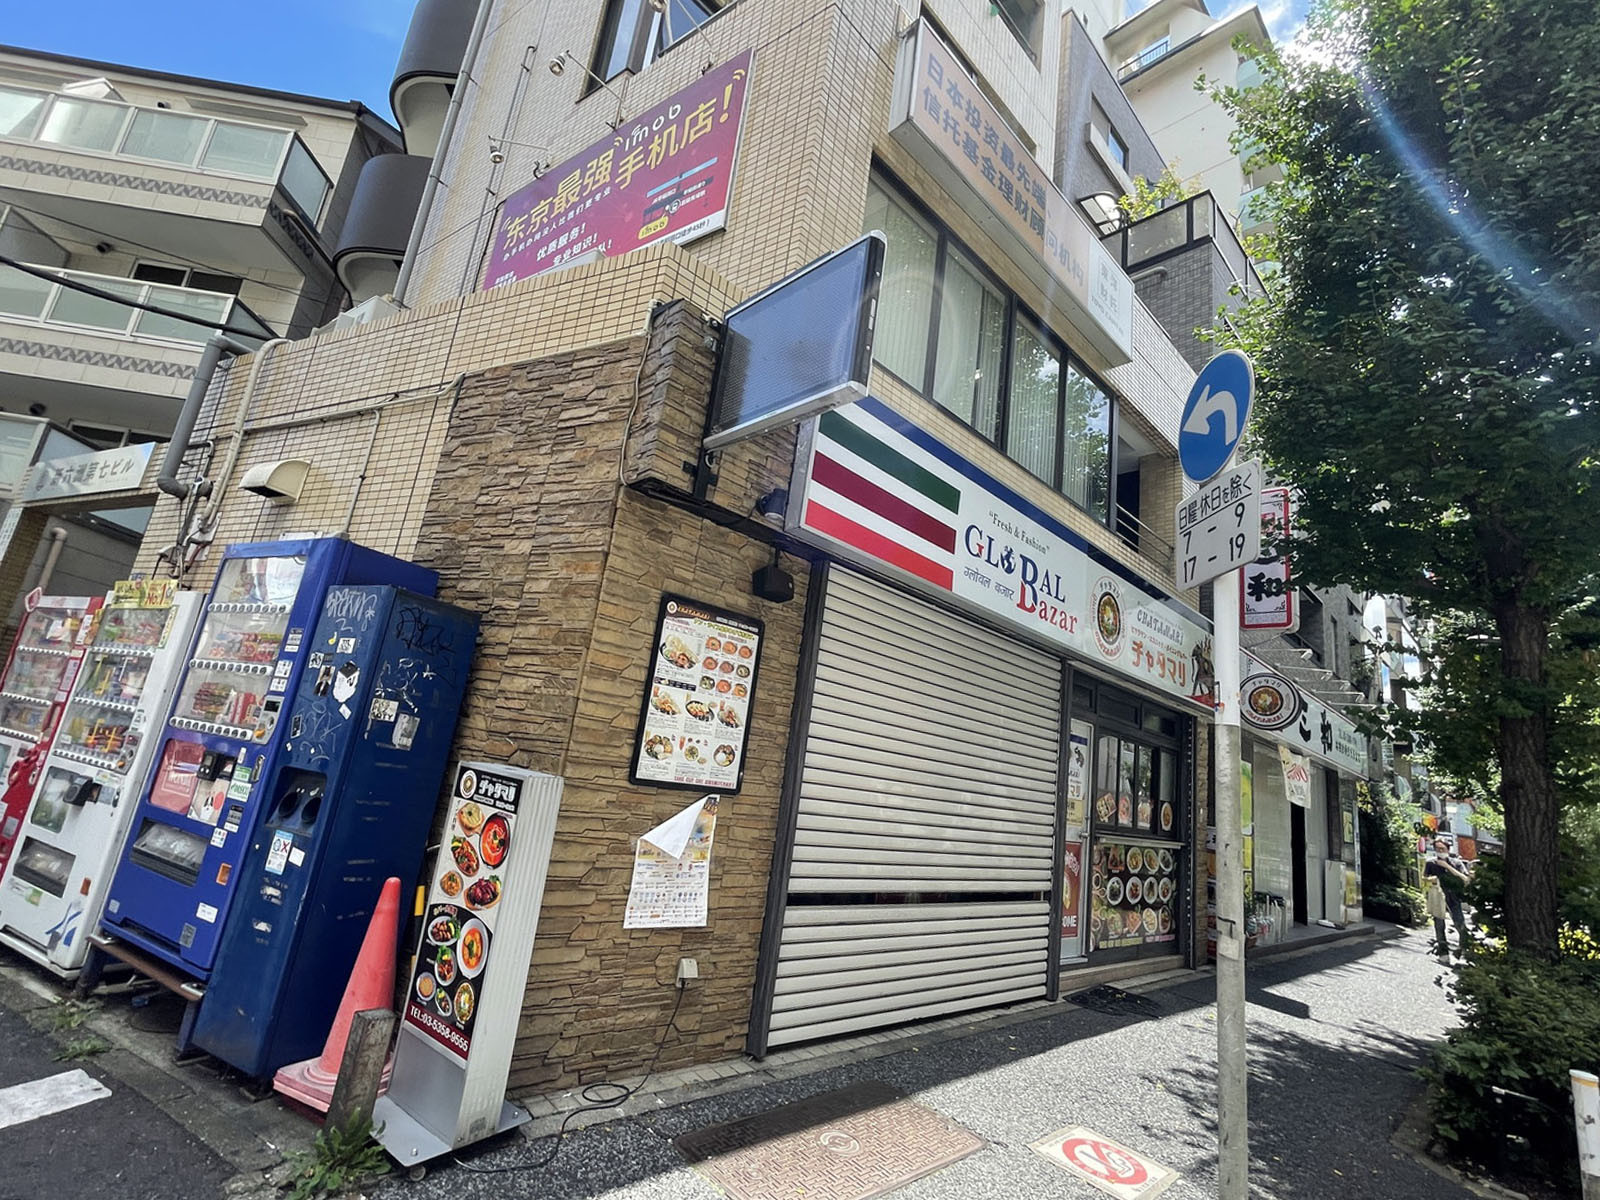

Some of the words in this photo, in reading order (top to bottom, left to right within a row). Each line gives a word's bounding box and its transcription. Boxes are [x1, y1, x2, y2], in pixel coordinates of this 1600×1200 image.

[1182, 530, 1192, 554] 7
[1234, 502, 1245, 527] 9
[1184, 556, 1197, 583] 17
[1229, 533, 1246, 562] 19
[1131, 639, 1186, 688] チャタマリ
